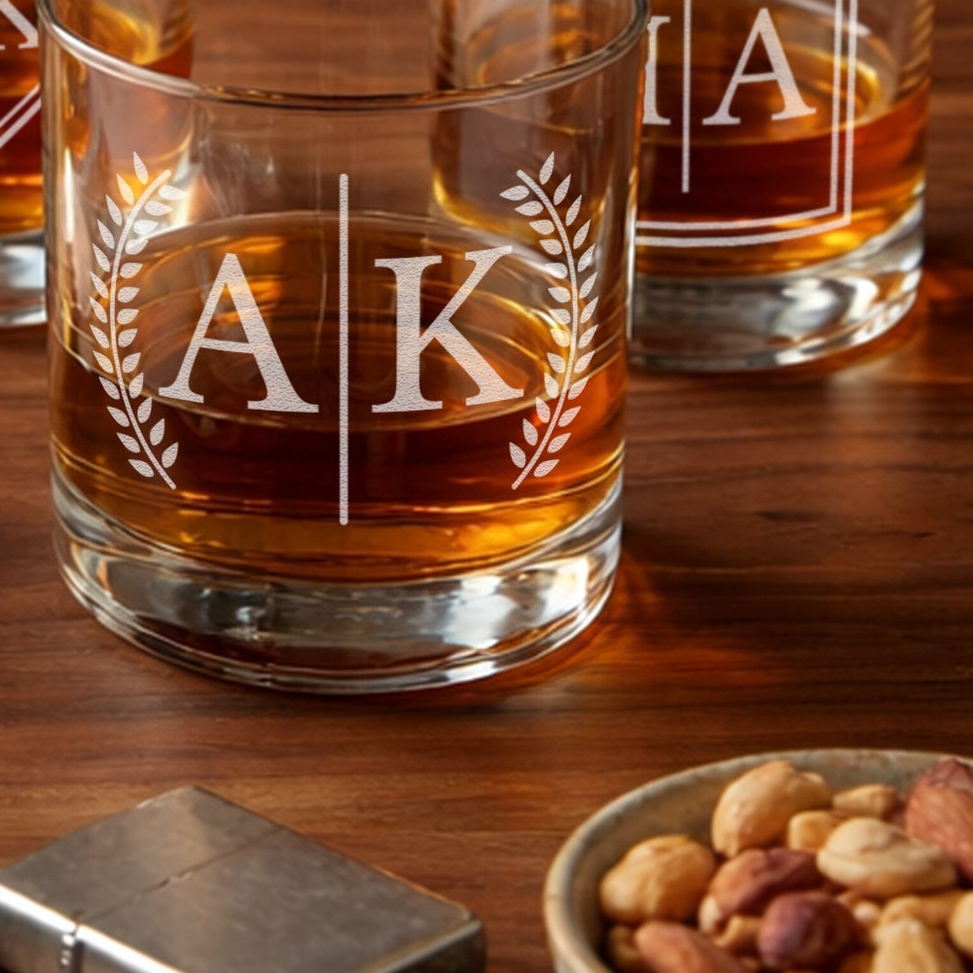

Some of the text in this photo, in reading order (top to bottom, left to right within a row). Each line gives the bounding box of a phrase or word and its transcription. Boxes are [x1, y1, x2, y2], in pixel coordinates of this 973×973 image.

[702, 7, 817, 125] A
[158, 245, 524, 414] A K
